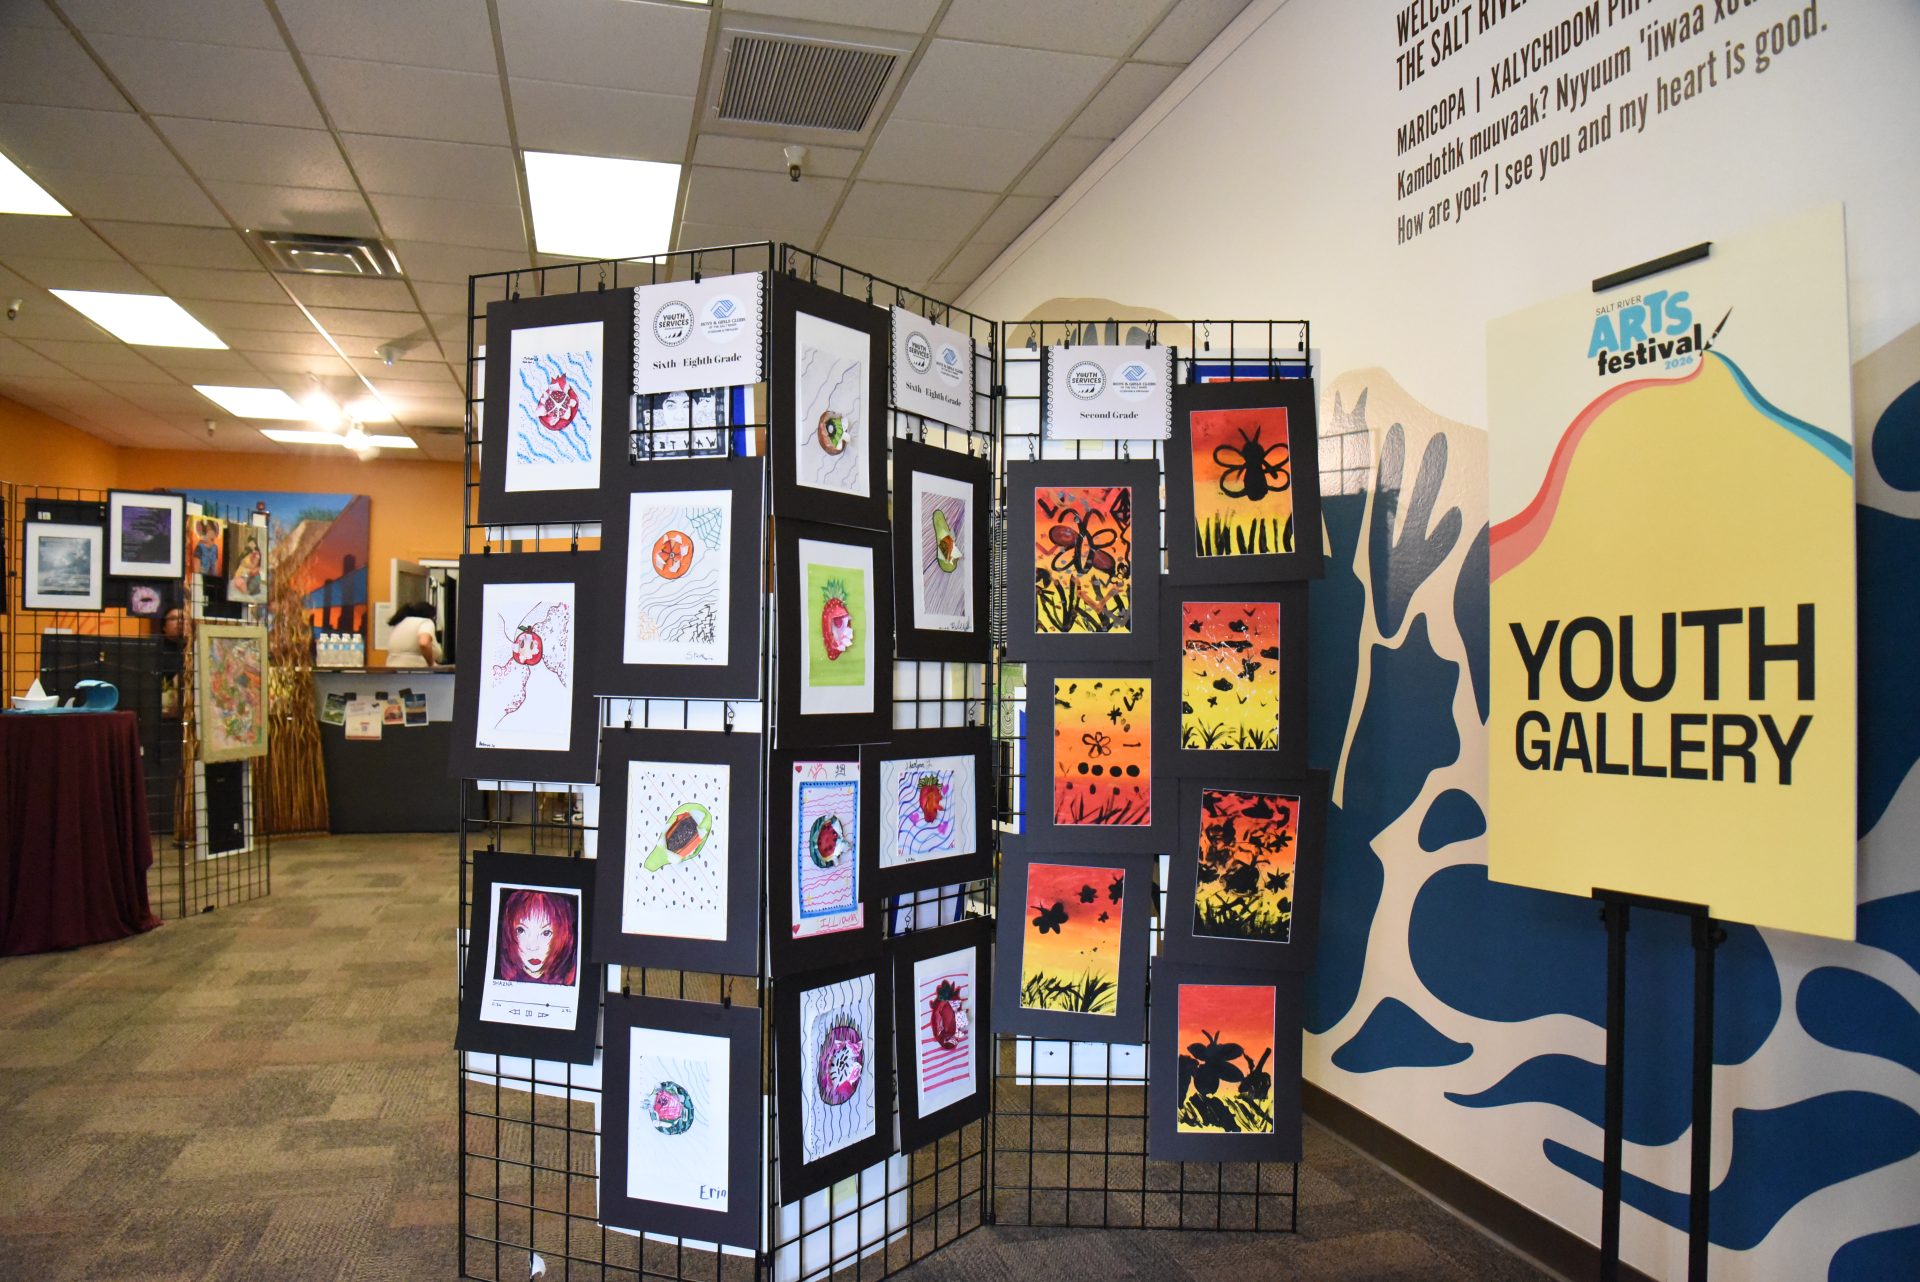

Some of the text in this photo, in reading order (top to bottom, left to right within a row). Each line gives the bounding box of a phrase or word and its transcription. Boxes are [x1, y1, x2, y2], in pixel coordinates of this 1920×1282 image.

[1396, 39, 1425, 91] THE
[1431, 4, 1472, 68] SALT
[1397, 86, 1466, 157] MARICOPA
[1490, 0, 1600, 99] XALYCHIDOM
[1397, 136, 1465, 201] Kamdothk
[1469, 84, 1549, 160] muuvaak?
[1556, 45, 1631, 113] Nyyuum
[1640, 4, 1705, 61] 'iiwaa
[1397, 211, 1424, 246] How
[1428, 198, 1451, 230] are
[1455, 169, 1489, 224] you?
[1494, 162, 1499, 196] I
[1504, 153, 1533, 190] see
[1539, 133, 1570, 182] you
[1578, 103, 1612, 154] and
[1619, 92, 1649, 134] my
[1656, 49, 1718, 115] heart
[1725, 39, 1746, 80] is
[1755, 0, 1828, 74] good.
[658, 319, 690, 329] SERVICES
[662, 312, 686, 321] YOUTH
[1587, 289, 1693, 359] ARTS
[1595, 294, 1643, 316] SALT RIVER
[652, 352, 742, 370] Sixth Eighth Grade
[1597, 323, 1703, 377] festival
[1664, 354, 1694, 370] 2026
[905, 381, 962, 407] Sixth Eighth Grade
[1080, 410, 1139, 420] Second Grade
[1508, 602, 1816, 703] YOUTH
[1515, 709, 1814, 786] GALLERY
[700, 1184, 727, 1200] Erin
